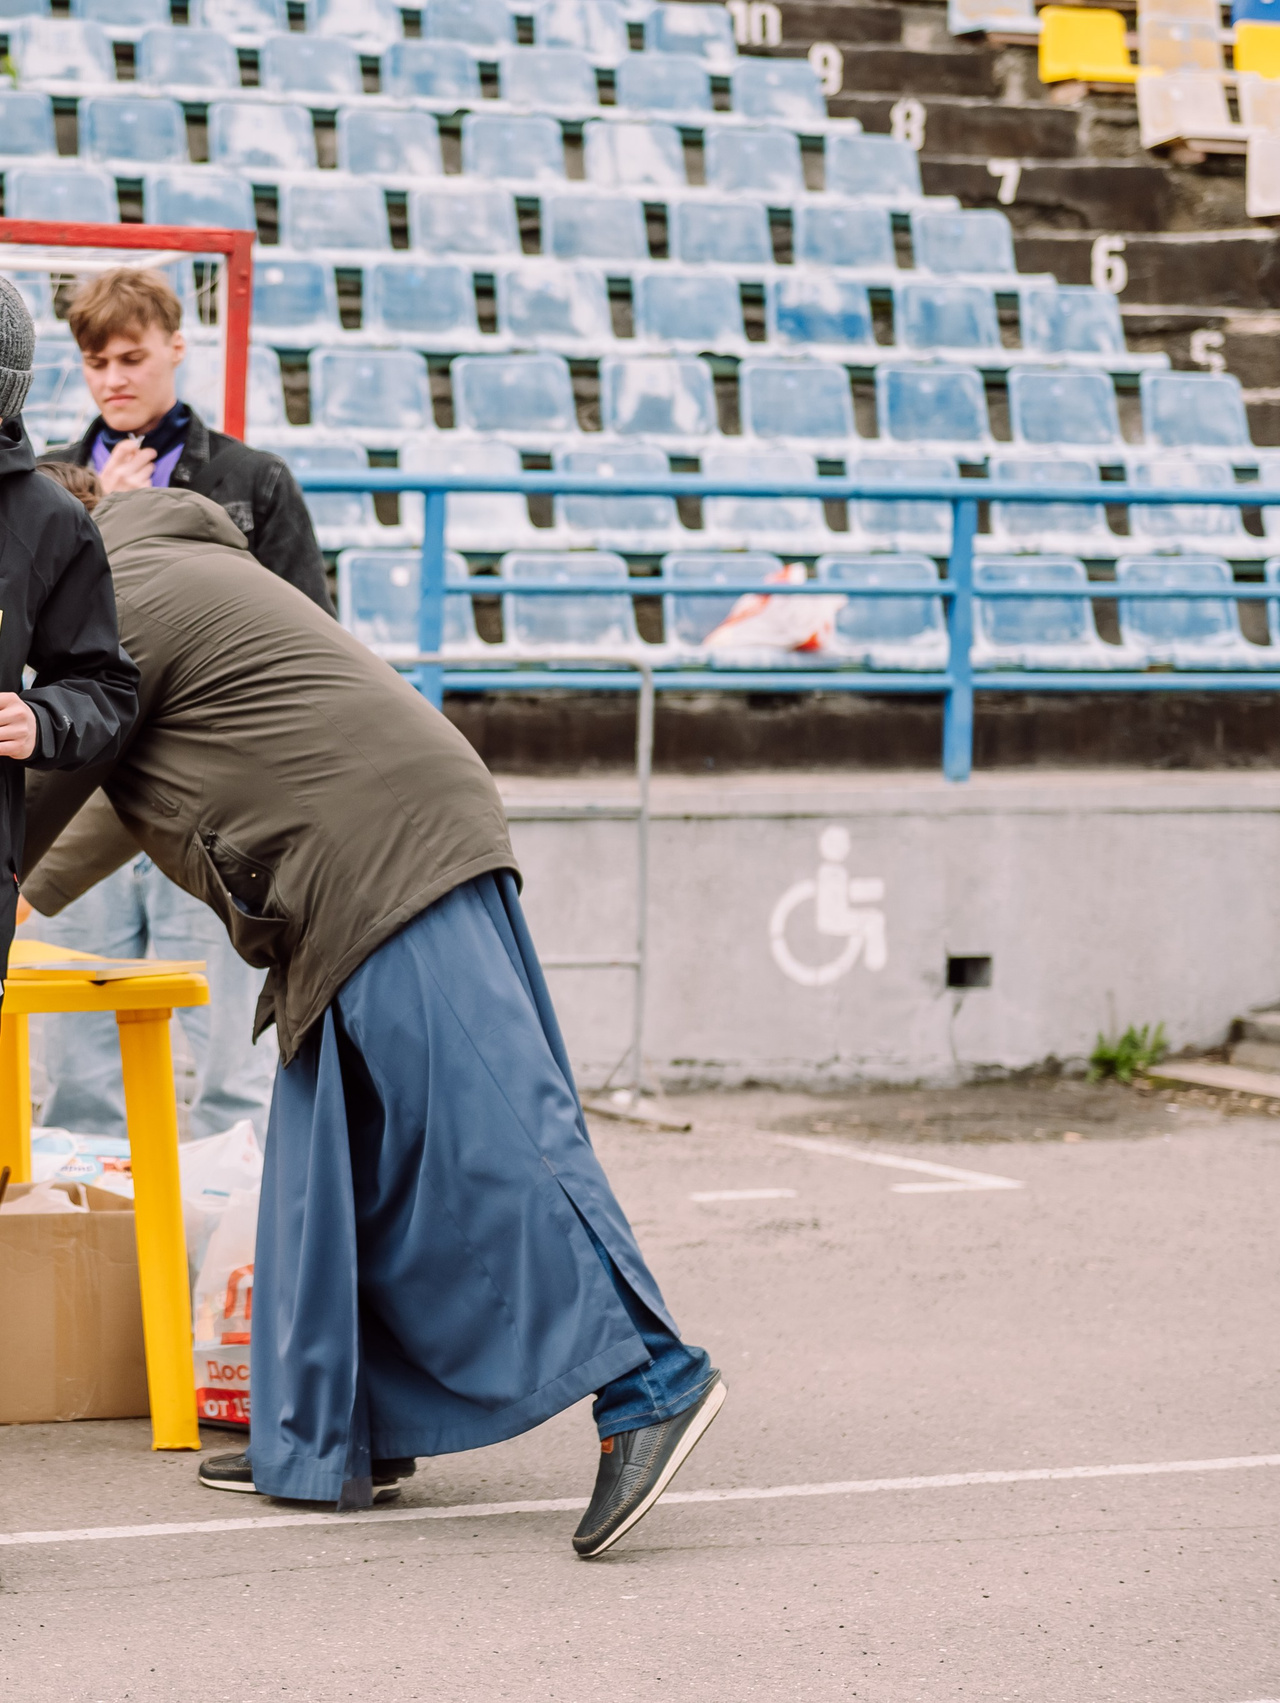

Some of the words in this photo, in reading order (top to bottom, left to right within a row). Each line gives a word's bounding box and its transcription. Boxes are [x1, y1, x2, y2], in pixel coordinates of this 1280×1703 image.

[729, 1, 782, 46] 10
[807, 41, 844, 96] 9
[889, 97, 927, 151] 8
[986, 159, 1021, 205] 7
[1090, 235, 1128, 294] 6
